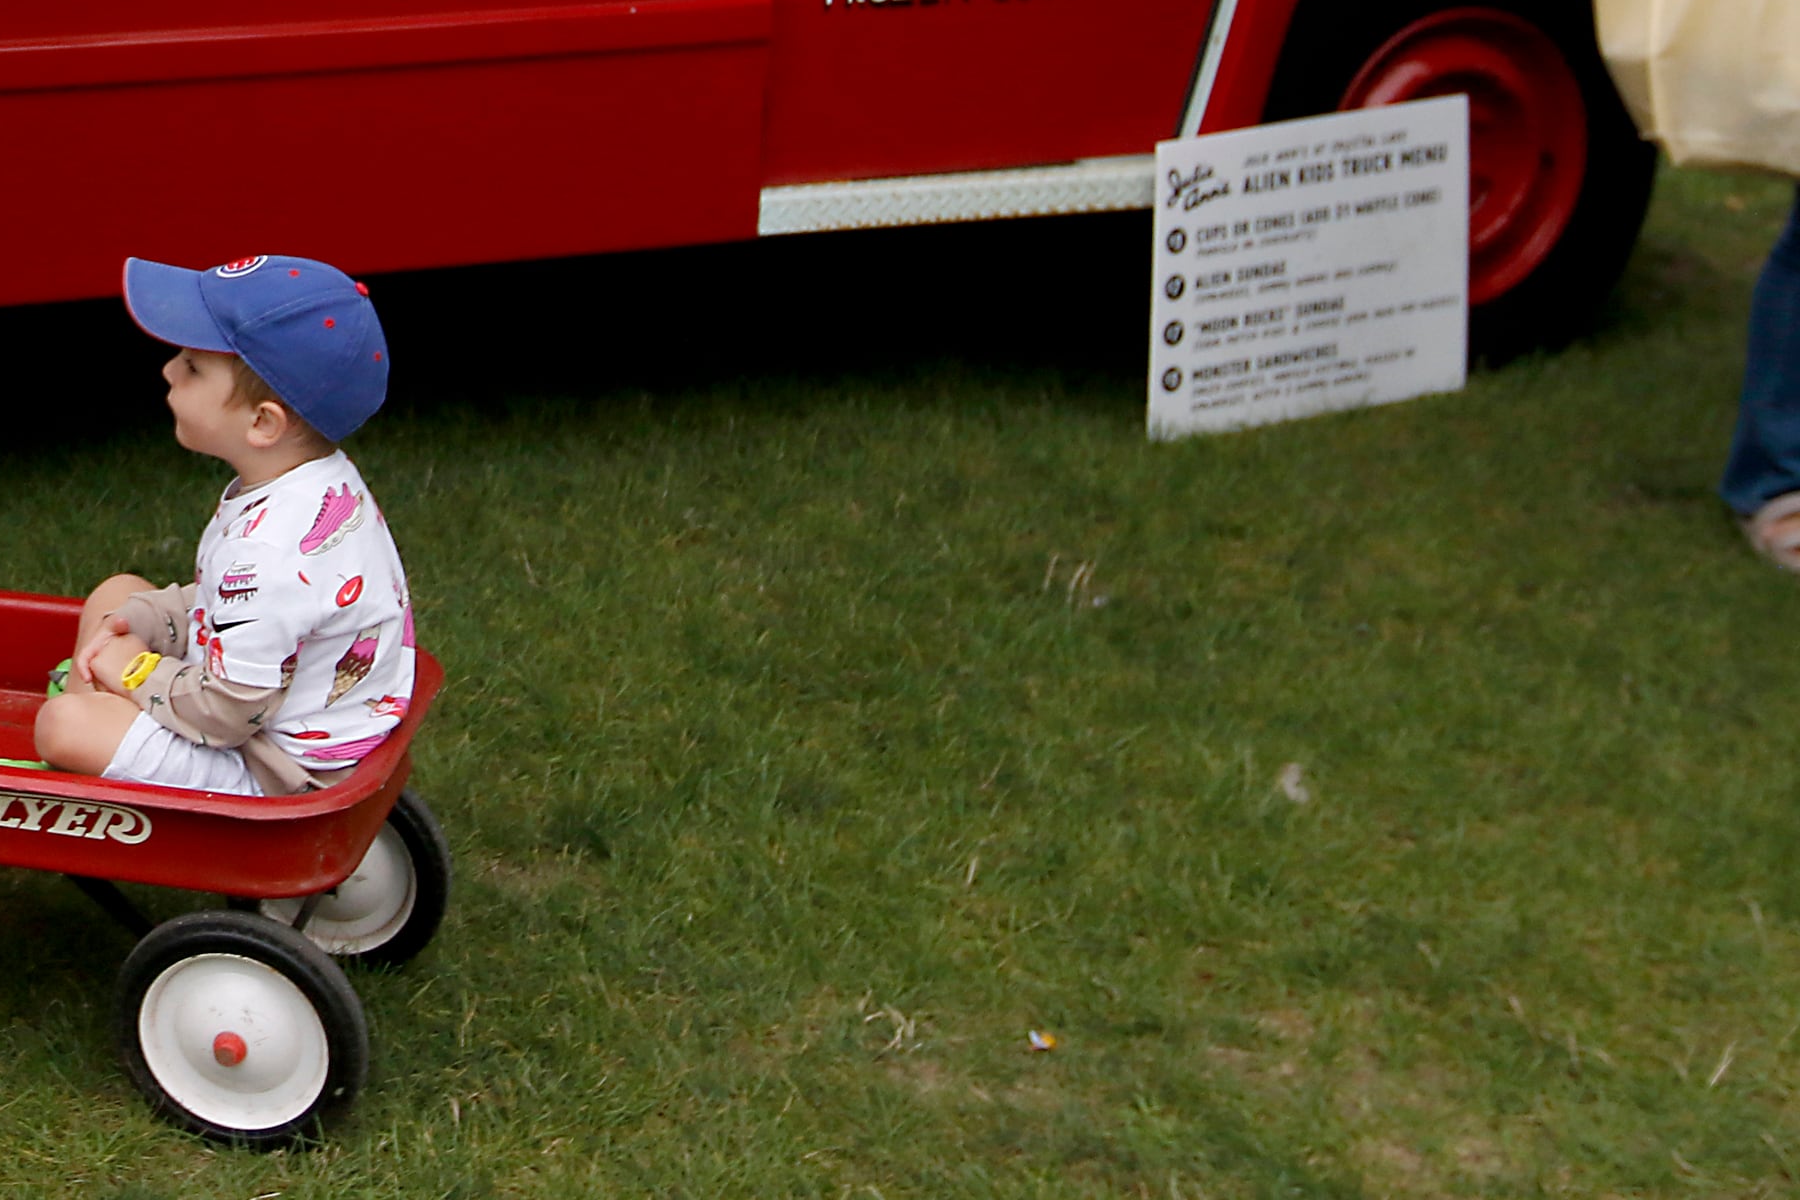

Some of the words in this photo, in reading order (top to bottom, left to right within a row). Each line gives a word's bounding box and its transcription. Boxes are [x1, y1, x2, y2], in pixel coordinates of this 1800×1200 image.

[1242, 168, 1290, 195] ALIEN
[1297, 160, 1334, 184] KIDS
[1342, 153, 1392, 177] TRUCK
[1400, 142, 1449, 166] MENU
[1196, 272, 1231, 290] ALIEN
[1237, 260, 1287, 282] SUNDAE
[1296, 296, 1345, 319] SUNDAE
[1192, 360, 1250, 381] MONSTER
[1256, 342, 1339, 370] SANDWICHES
